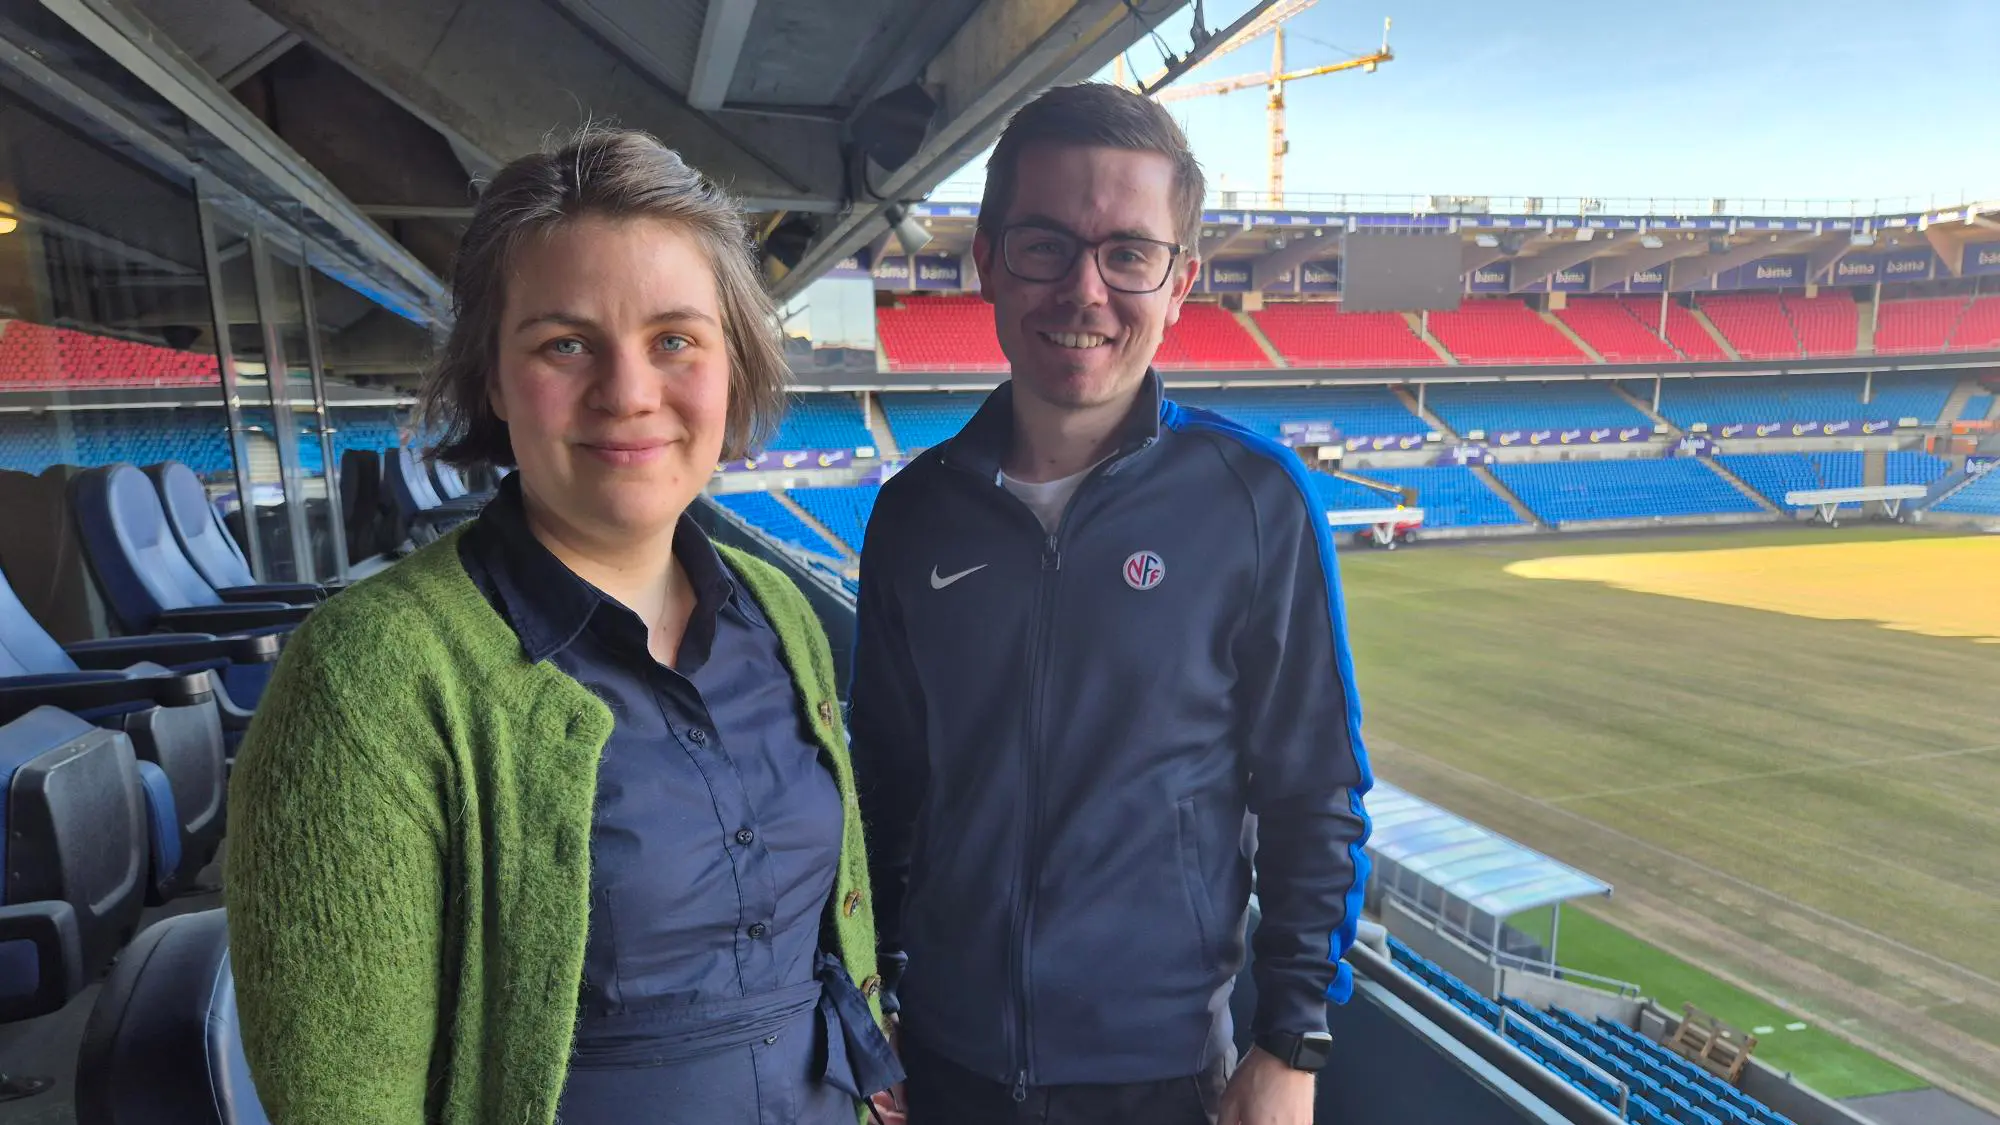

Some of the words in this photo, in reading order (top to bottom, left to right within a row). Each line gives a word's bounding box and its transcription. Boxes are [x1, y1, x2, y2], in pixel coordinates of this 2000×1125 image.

[1757, 265, 1793, 279] bama
[1839, 263, 1875, 276] bama
[1887, 260, 1925, 274] bama
[1126, 553, 1161, 587] NFF
